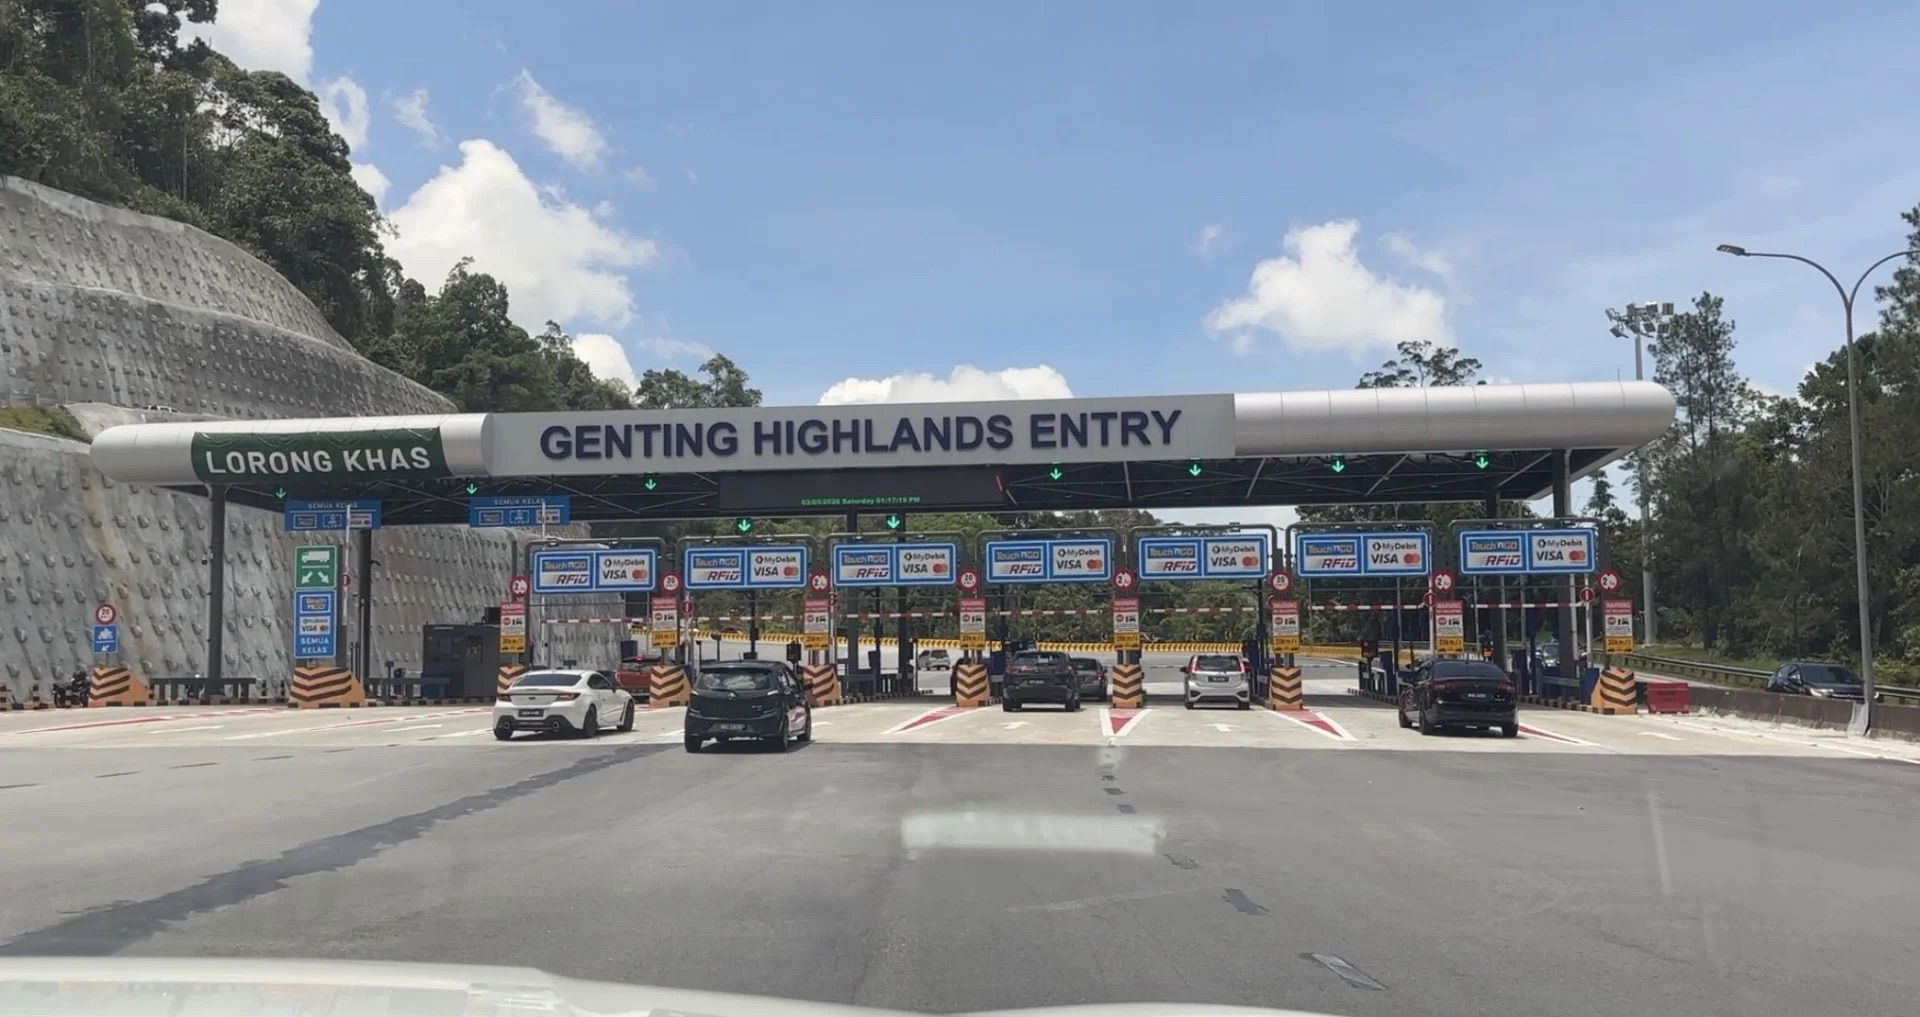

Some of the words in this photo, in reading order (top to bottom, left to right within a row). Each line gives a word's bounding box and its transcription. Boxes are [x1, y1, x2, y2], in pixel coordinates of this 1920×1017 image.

[540, 421, 738, 461] GENTING
[753, 413, 1013, 456] HIGHLANDS
[1030, 410, 1182, 449] ENTRY
[207, 450, 333, 476] LORONG
[344, 446, 431, 473] KHAS
[1382, 543, 1417, 552] MyDebit
[1547, 539, 1582, 548] MyDebit
[1067, 549, 1100, 557] MyDebit
[1221, 546, 1256, 554] MyDebit
[764, 555, 796, 564] MyDebit
[913, 553, 946, 561] MyDebit
[1371, 553, 1399, 564] VISA
[1536, 550, 1564, 561] VISA
[613, 559, 645, 568] MyDebit
[1056, 560, 1082, 570] VISA
[1211, 557, 1237, 567] VISA
[754, 566, 779, 576] VISA
[902, 564, 928, 573] VISA
[602, 570, 628, 580] VISA
[301, 637, 329, 645] SEMUA
[302, 646, 327, 654] KELAS
